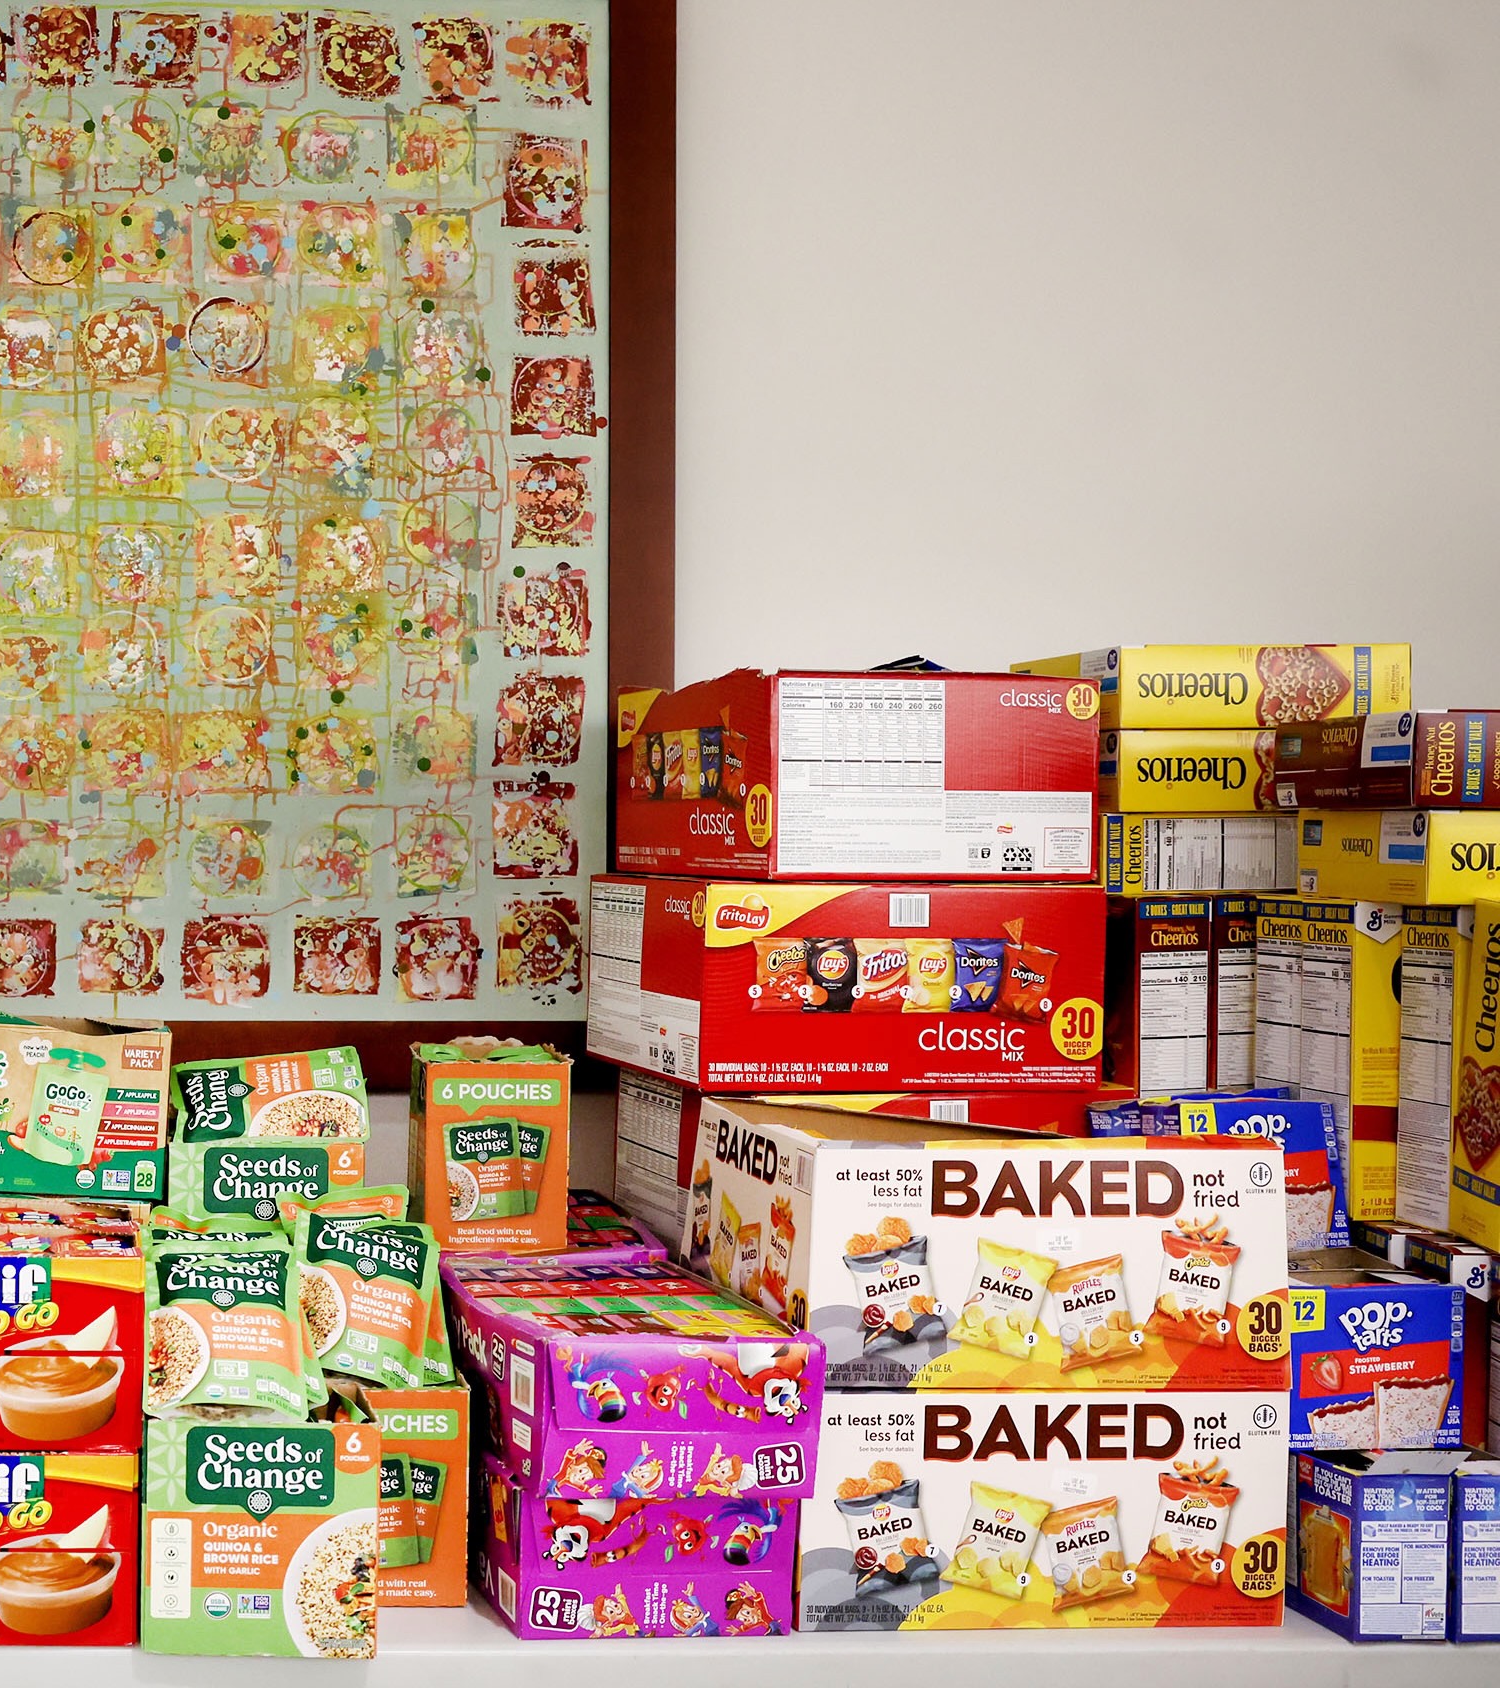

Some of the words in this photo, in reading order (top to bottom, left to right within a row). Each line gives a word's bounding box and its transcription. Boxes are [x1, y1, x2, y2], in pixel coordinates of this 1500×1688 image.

[1356, 654, 1369, 670] VALUE
[1137, 672, 1249, 706] Cheerios
[1356, 670, 1369, 690] GREAT
[1000, 689, 1062, 708] classic
[1072, 687, 1092, 707] 30
[1469, 720, 1483, 740] VALUE
[1430, 721, 1455, 796] Cheerios
[1468, 741, 1482, 763] GREAT
[1136, 757, 1247, 790] Cheerios
[1466, 768, 1480, 788] BOXES
[750, 794, 766, 826] 30
[690, 807, 735, 835] classic
[725, 836, 736, 846] MIX
[1125, 826, 1142, 884] Cheerios
[665, 896, 691, 915] classic
[1151, 931, 1198, 946] Cheerios
[1262, 919, 1302, 938] Cheerios
[1307, 924, 1348, 944] Cheerios
[1407, 927, 1449, 948] Cheerios
[767, 946, 806, 972] Cheetos
[961, 956, 998, 967] Doritos
[1475, 923, 1500, 1052] Cheerios
[1062, 1007, 1095, 1039] 30
[918, 1022, 1026, 1051] classic
[124, 1048, 161, 1060] VARIETY
[130, 1059, 154, 1068] PACK
[1002, 1052, 1024, 1061] MIX
[442, 1084, 452, 1099] 6
[459, 1084, 552, 1100] POUCHES
[1188, 1114, 1208, 1132] 12
[338, 1150, 351, 1168] 6
[716, 1119, 778, 1185] BAKED
[220, 1154, 301, 1179] Seeds
[303, 1165, 319, 1177] of
[836, 1170, 852, 1181] at
[856, 1169, 890, 1182] least
[896, 1169, 923, 1182] 50%
[137, 1172, 153, 1188] 28
[1193, 1170, 1225, 1187] not
[873, 1185, 899, 1197] less
[904, 1185, 922, 1197] fat
[931, 1160, 1185, 1218] BAKED
[1194, 1190, 1240, 1208] fried
[316, 1224, 418, 1273] Change
[741, 1249, 757, 1261] BAKED
[770, 1235, 787, 1259] BAKED
[865, 1274, 920, 1298] BAKED
[980, 1276, 1033, 1302] BAKED
[1169, 1269, 1221, 1290] BAKED
[352, 1280, 414, 1306] Organic
[1063, 1289, 1116, 1312] BAKED
[211, 1312, 281, 1328] Organic
[1249, 1301, 1282, 1334] 30
[1293, 1301, 1315, 1321] 12
[212, 1334, 255, 1344] BROWN
[258, 1336, 284, 1347] RICE
[1349, 1361, 1416, 1375] STRAWBERRY
[828, 1416, 842, 1426] at
[848, 1414, 882, 1426] least
[888, 1414, 915, 1426] 50%
[1194, 1412, 1227, 1429] not
[346, 1432, 361, 1453] 6
[865, 1430, 891, 1441] less
[896, 1430, 914, 1441] fat
[923, 1404, 1185, 1462] BAKED
[1194, 1432, 1241, 1450] fried
[204, 1435, 302, 1463] Seeds
[304, 1449, 323, 1463] of
[197, 1460, 323, 1494] Change
[1314, 1486, 1352, 1506] TOASTER
[202, 1521, 278, 1540] Organic
[857, 1517, 913, 1541] BAKED
[1066, 1520, 1096, 1536] RUFFLES
[1164, 1510, 1217, 1531] BAKED
[972, 1518, 1026, 1544] BAKED
[1056, 1530, 1110, 1554] BAKED
[203, 1553, 248, 1564] BROWN
[251, 1554, 278, 1565] RICE
[1244, 1541, 1278, 1574] 30
[204, 1566, 226, 1575] WITH
[228, 1567, 260, 1576] GARLIC
[385, 1580, 404, 1588] with
[407, 1580, 426, 1588] real
[536, 1590, 558, 1626] 25
[562, 1600, 571, 1623] mini
